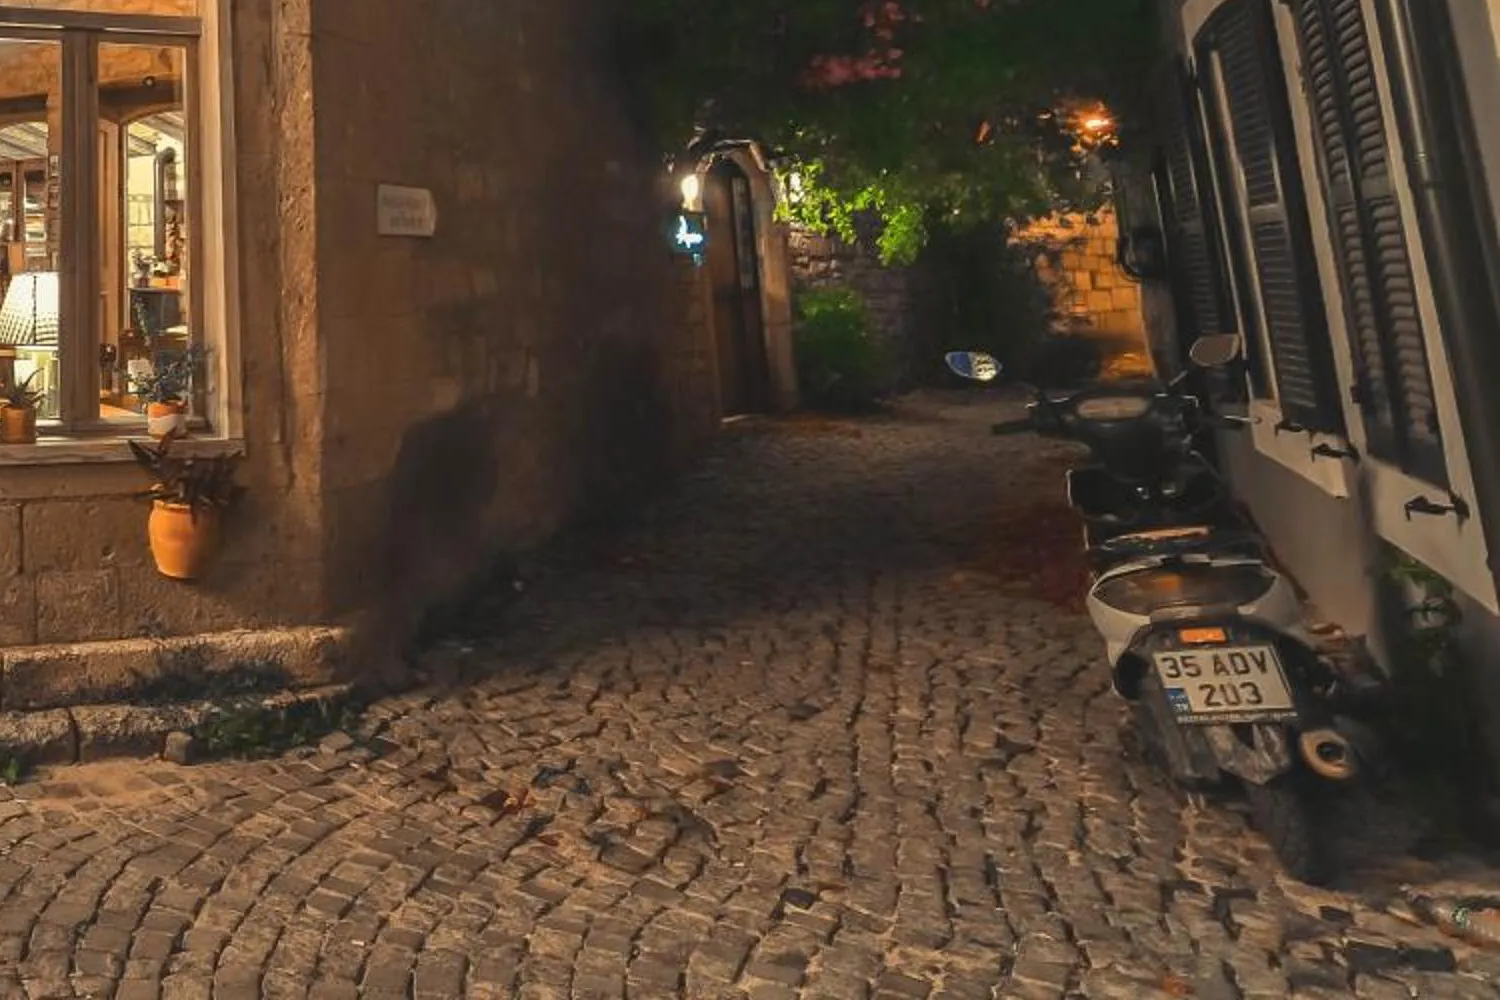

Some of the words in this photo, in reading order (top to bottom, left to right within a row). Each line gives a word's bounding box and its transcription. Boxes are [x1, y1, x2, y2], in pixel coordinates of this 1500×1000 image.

[1161, 655, 1202, 679] 35
[1212, 651, 1268, 677] ADV
[1199, 681, 1263, 707] 203
